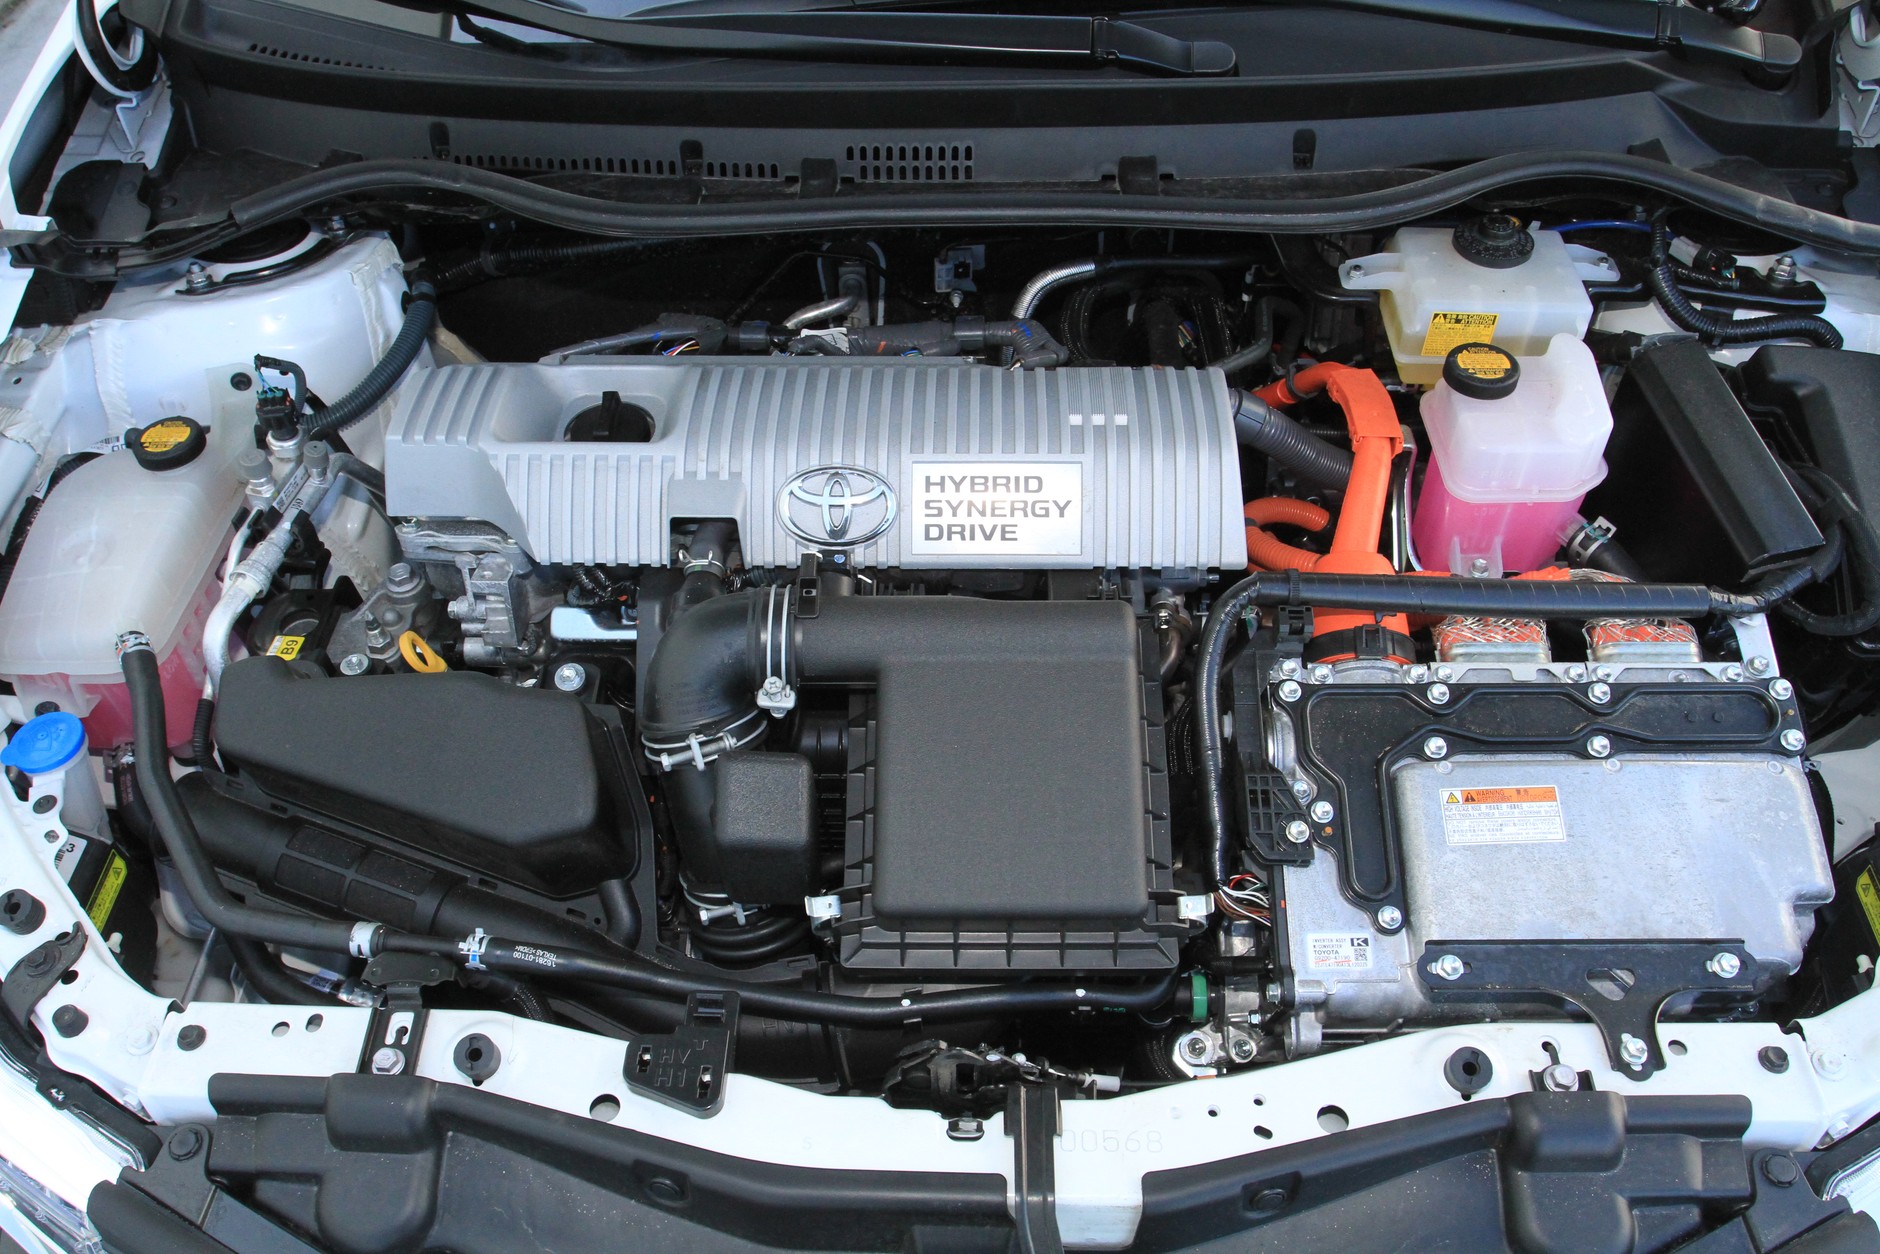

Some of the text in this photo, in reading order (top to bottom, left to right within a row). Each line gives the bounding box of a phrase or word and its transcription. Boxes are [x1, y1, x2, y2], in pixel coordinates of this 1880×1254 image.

[925, 475, 1043, 493] HYBRID
[924, 500, 1072, 518] SYNERGY
[924, 524, 1018, 541] DRIVE
[280, 639, 298, 654] B9
[1476, 789, 1505, 797] WARNING
[1352, 938, 1367, 946] K
[513, 951, 556, 968] 16281-0T100
[1060, 1129, 1163, 1153] 00568
